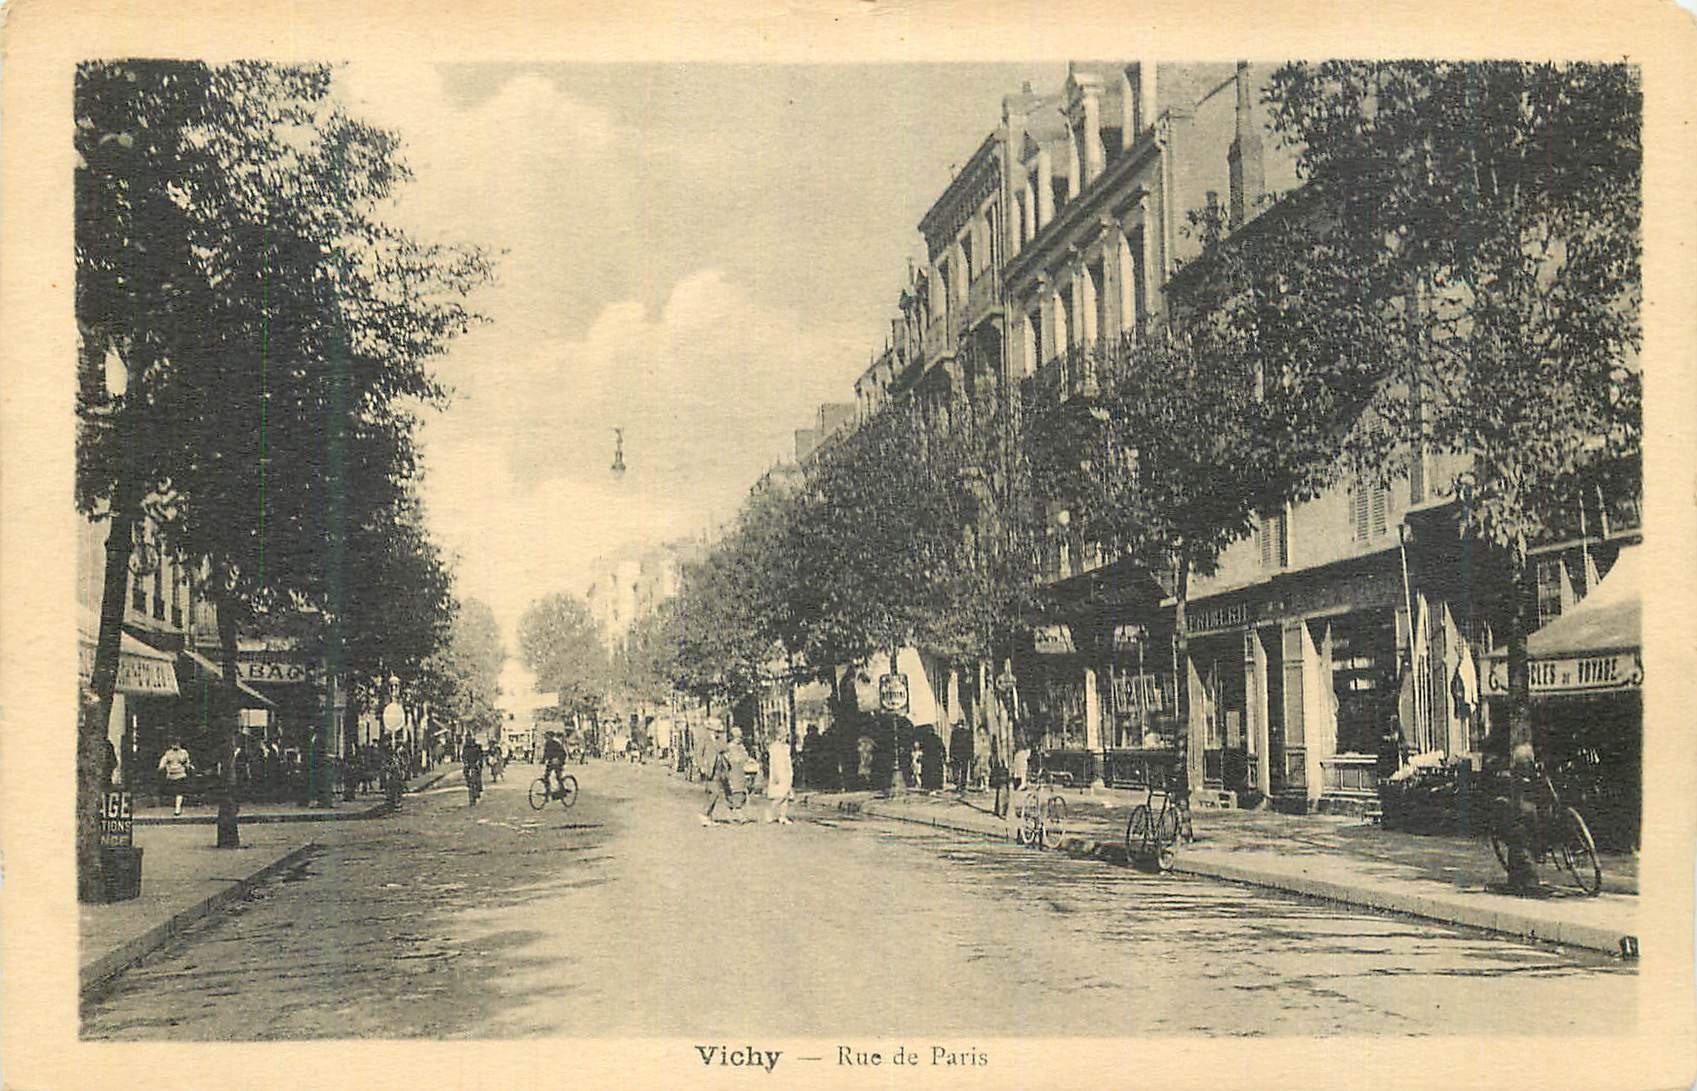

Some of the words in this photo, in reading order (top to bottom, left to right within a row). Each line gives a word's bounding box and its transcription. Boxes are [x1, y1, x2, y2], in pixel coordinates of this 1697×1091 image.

[1531, 663, 1556, 685] CLES
[1578, 658, 1617, 683] VOYAGE
[100, 820, 131, 832] TIONS
